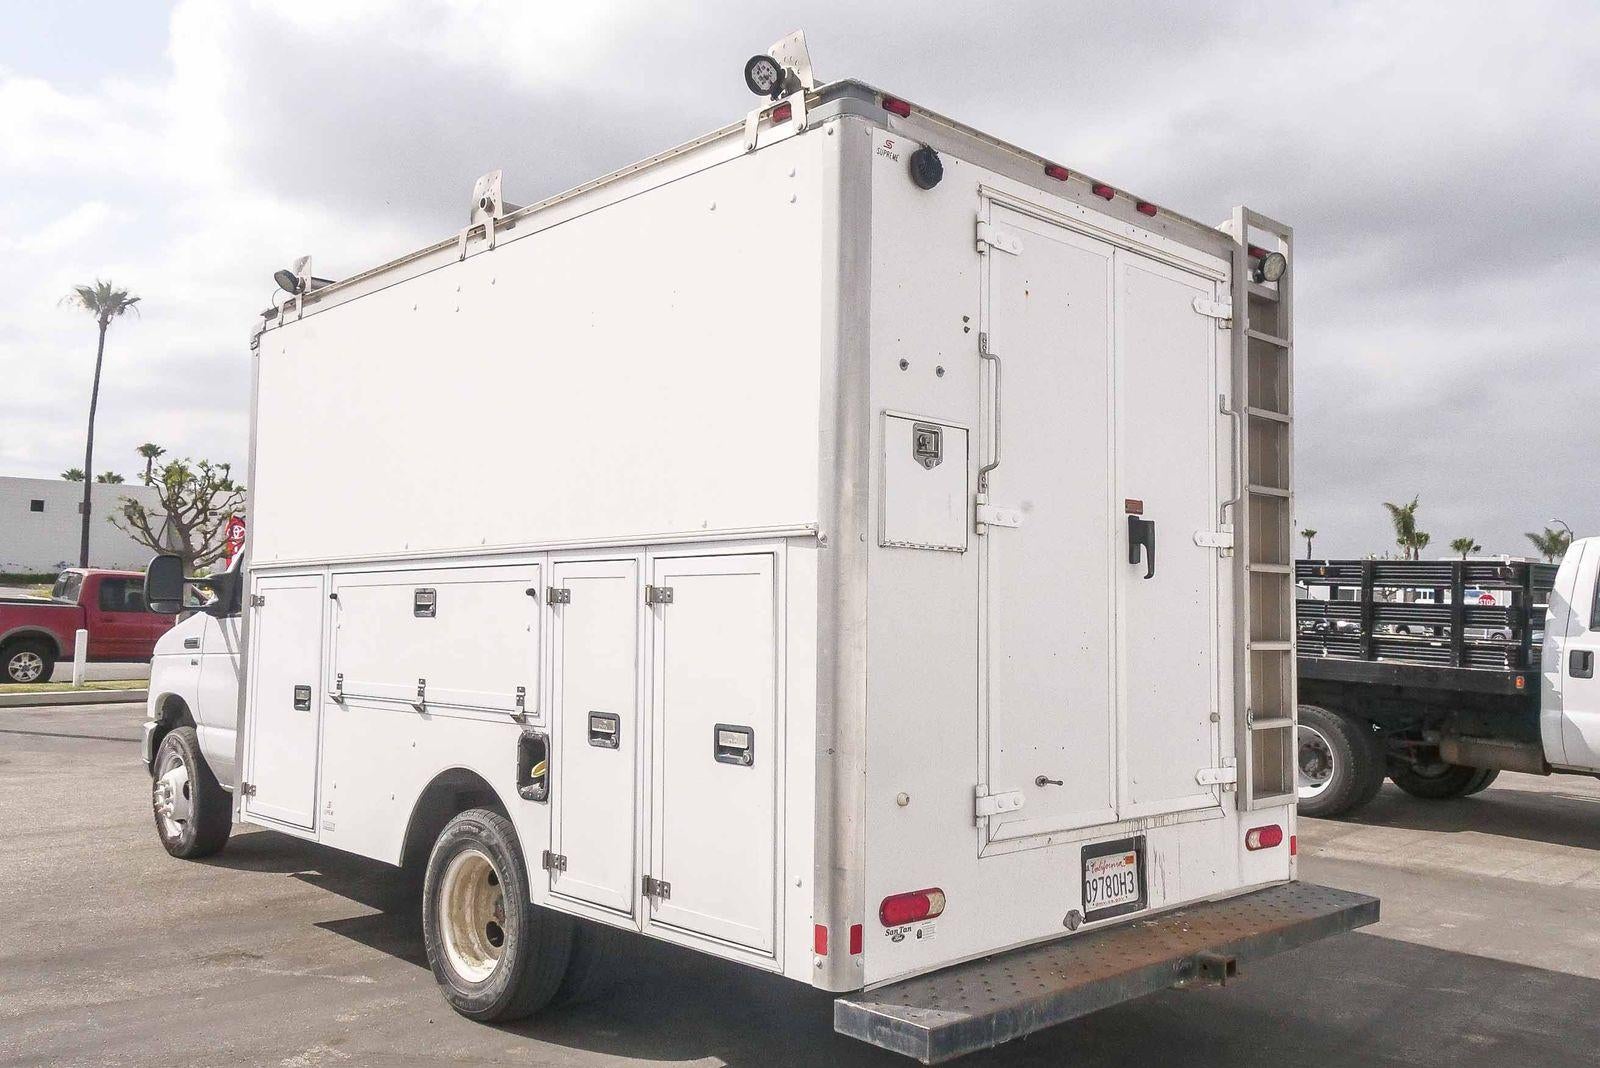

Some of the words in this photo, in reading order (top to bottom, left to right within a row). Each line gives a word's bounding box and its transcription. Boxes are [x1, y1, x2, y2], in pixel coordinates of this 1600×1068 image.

[876, 147, 900, 162] SUPREME
[1085, 870, 1135, 904] 09780H3
[884, 928, 900, 937] San
